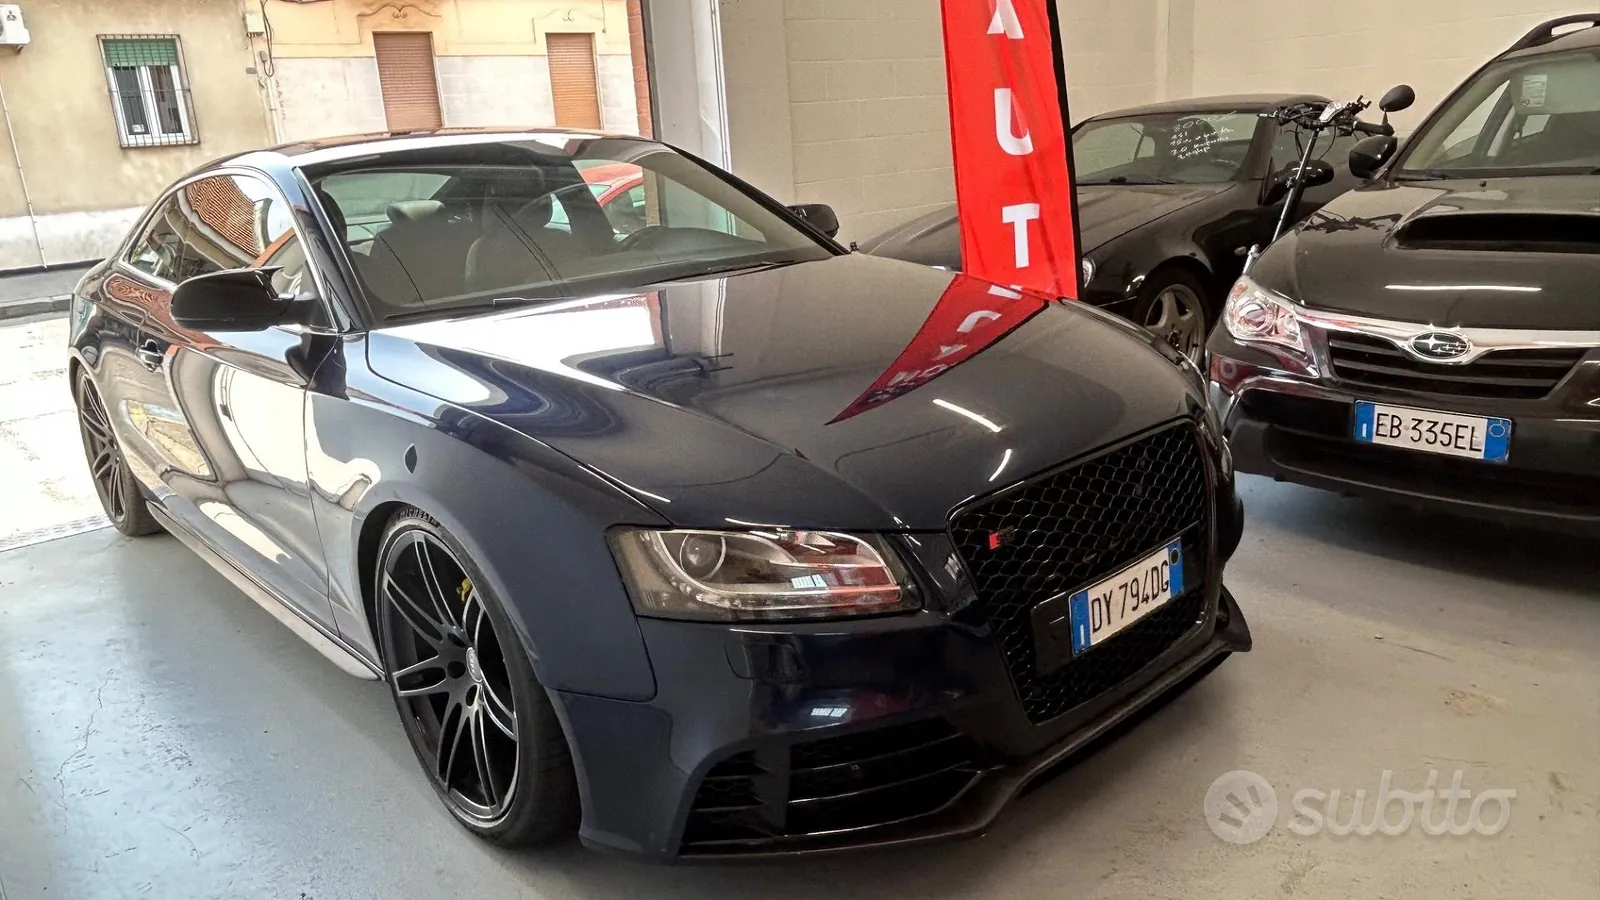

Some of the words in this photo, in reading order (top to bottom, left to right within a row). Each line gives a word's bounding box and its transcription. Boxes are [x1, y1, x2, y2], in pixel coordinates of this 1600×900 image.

[1375, 412, 1402, 439] EB
[1410, 417, 1482, 452] 335EL
[1091, 589, 1113, 634] DY
[1118, 559, 1169, 619] 794DG
